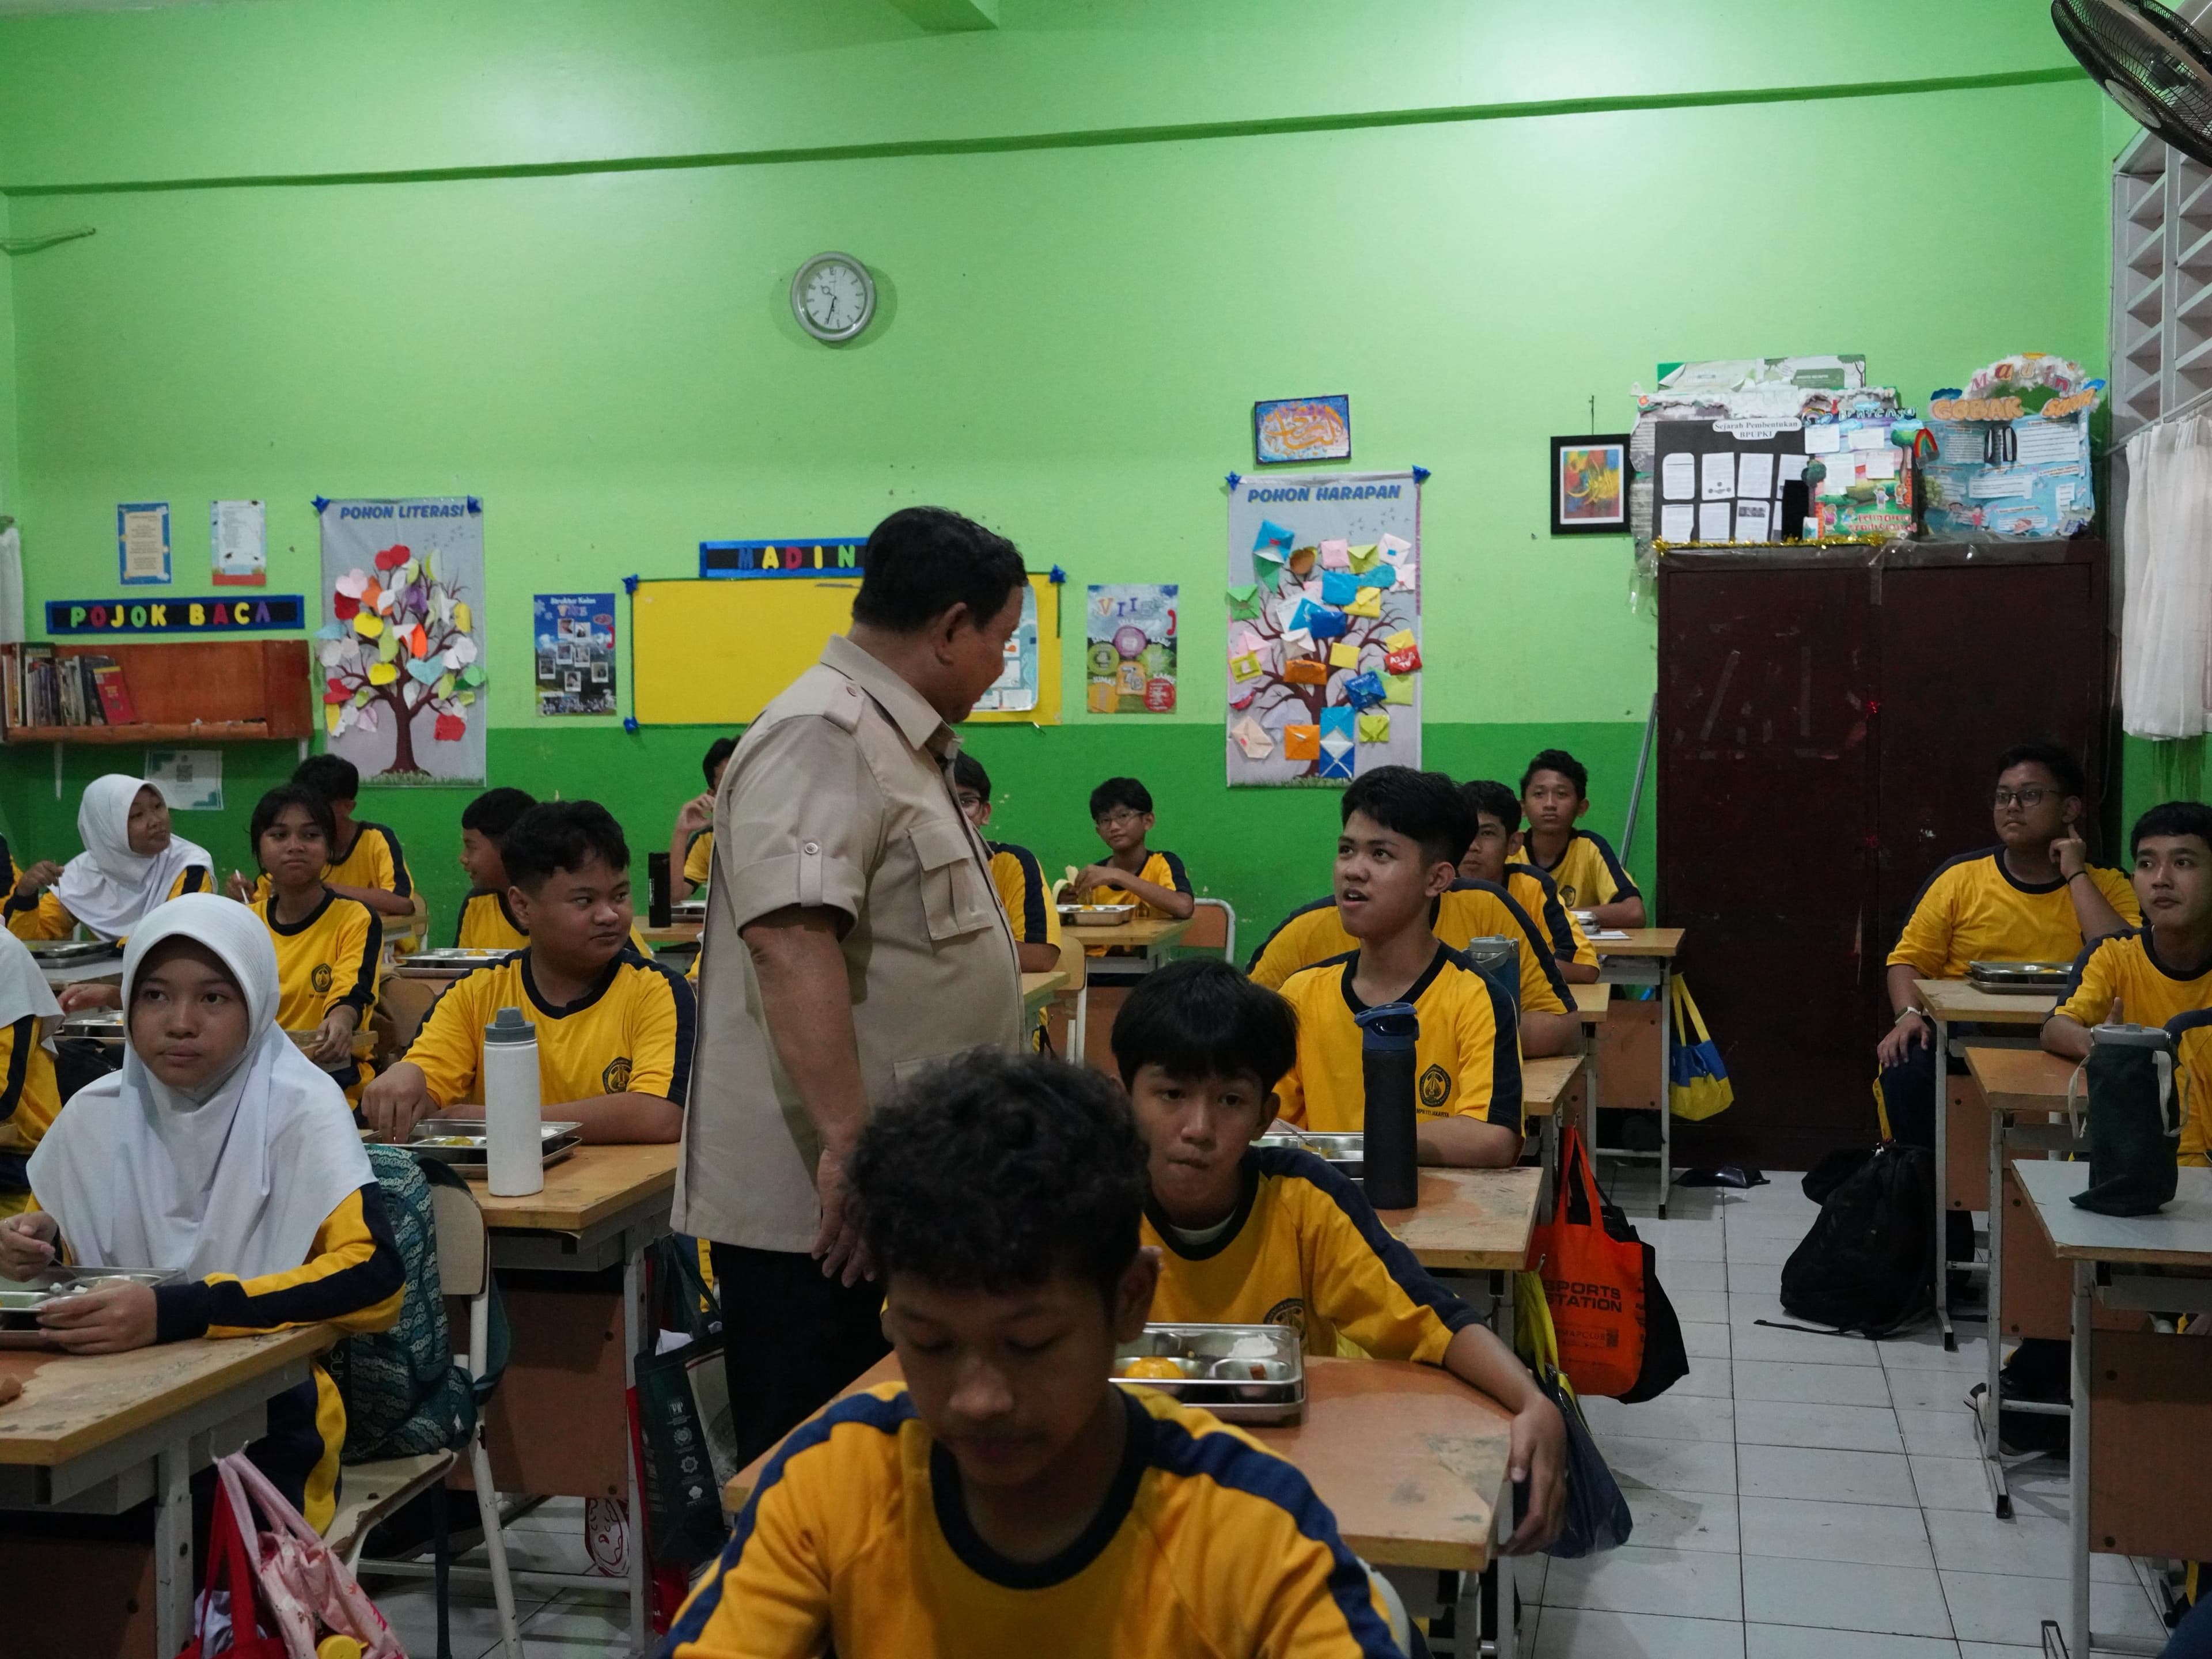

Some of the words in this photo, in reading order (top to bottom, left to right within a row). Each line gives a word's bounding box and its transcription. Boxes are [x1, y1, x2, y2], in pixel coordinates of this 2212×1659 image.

[1933, 397, 2024, 421] GOBAK
[1714, 422, 1744, 431] Sejarah
[1746, 421, 1798, 429] Pembentukan
[1247, 488, 1310, 503] POHON
[1316, 485, 1402, 501] HARAPAN
[340, 505, 394, 520] POHON
[399, 503, 465, 518] LITERASI
[738, 544, 855, 570] MADIN
[70, 605, 168, 628] POJOK
[189, 601, 271, 626] BACA
[1543, 1279, 1621, 1300] SPORTS
[1544, 1293, 1622, 1313] STATION
